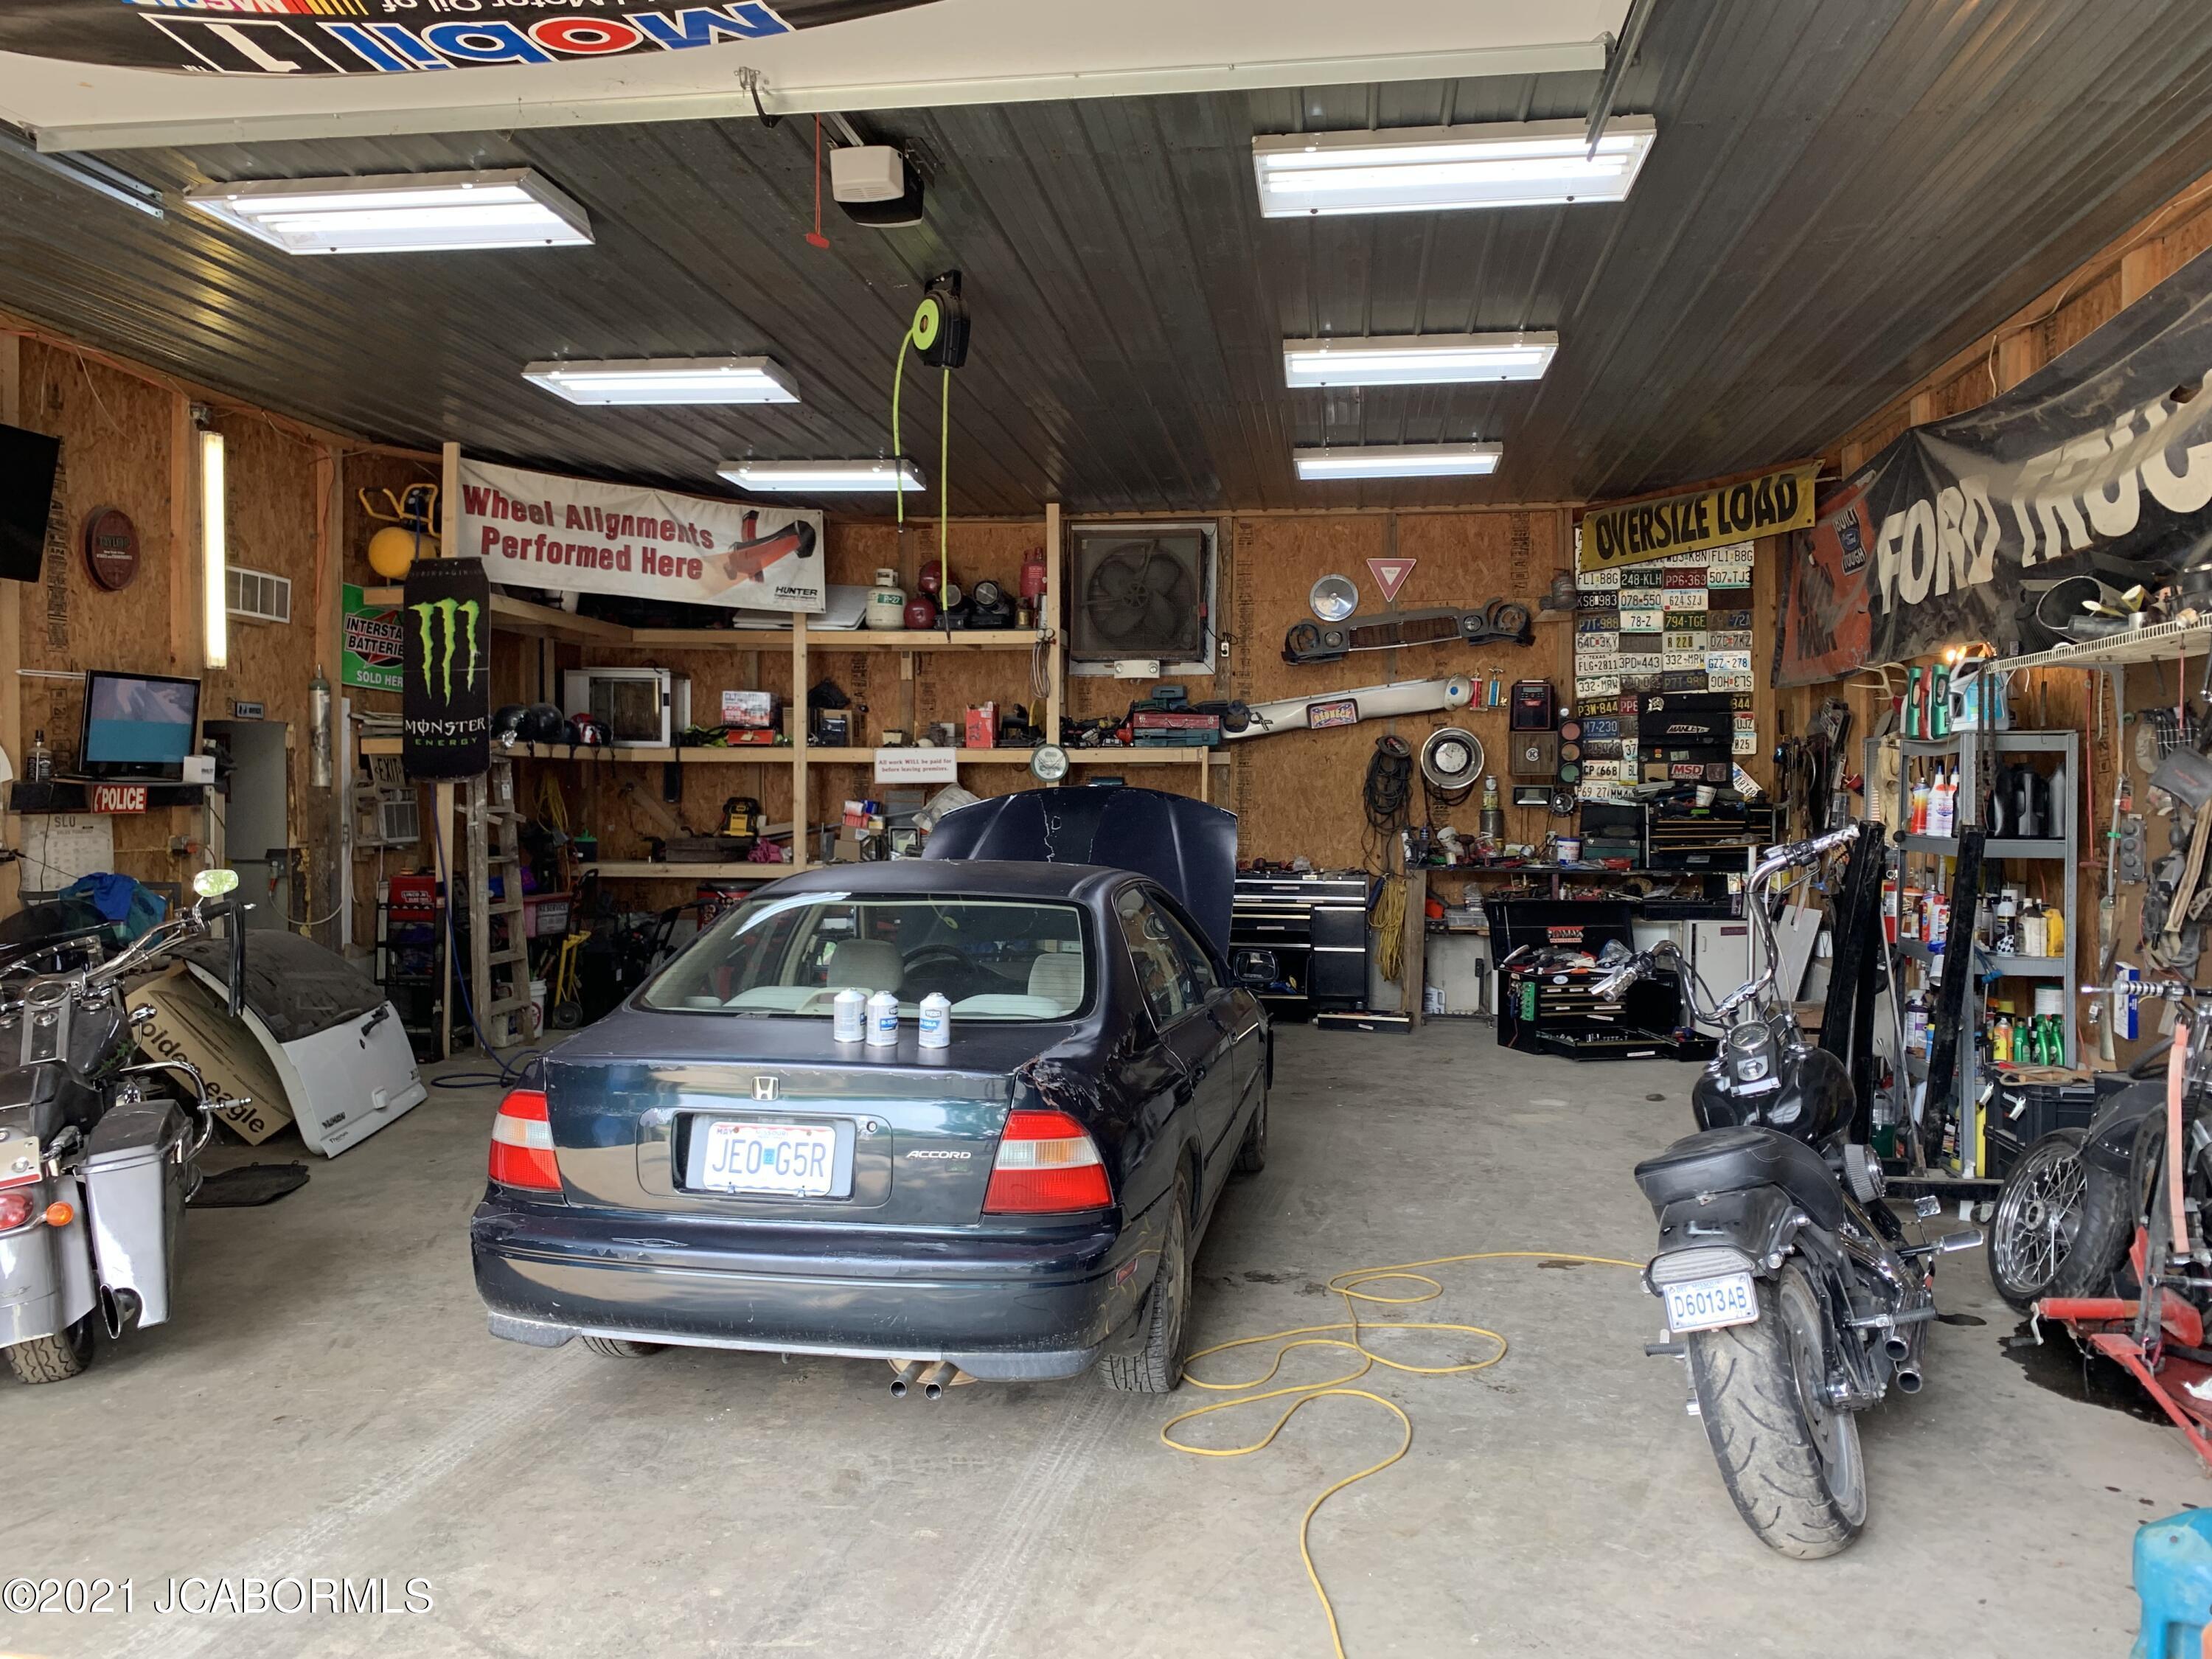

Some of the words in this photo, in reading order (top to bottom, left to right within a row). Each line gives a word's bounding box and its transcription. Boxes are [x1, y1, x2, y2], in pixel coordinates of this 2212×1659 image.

[316, 0, 796, 72] Mobil
[462, 484, 554, 528] Wheel
[566, 504, 714, 549] Alignments
[1596, 498, 1711, 560] OVERSIZE
[1718, 473, 1798, 535] LOAD
[481, 526, 632, 573] Performed
[642, 547, 703, 580] Here
[1877, 473, 2001, 615] FORD
[775, 586, 818, 596] HUNTER
[347, 615, 404, 641] INTERSTA
[348, 636, 404, 657] BATTERIE
[356, 670, 382, 686] SOLD
[384, 673, 404, 688] HER
[405, 717, 487, 737] MONSTER
[414, 737, 479, 747] ENERGY
[378, 757, 400, 783] EXIT
[930, 758, 942, 766] paid
[1672, 765, 1703, 774] MSD
[102, 787, 145, 811] POLICE
[54, 815, 77, 828] SLU
[205, 1081, 265, 1134] eagle
[716, 1127, 734, 1135] MAY
[774, 1141, 827, 1178] G5R
[906, 1150, 973, 1159] ACCORD
